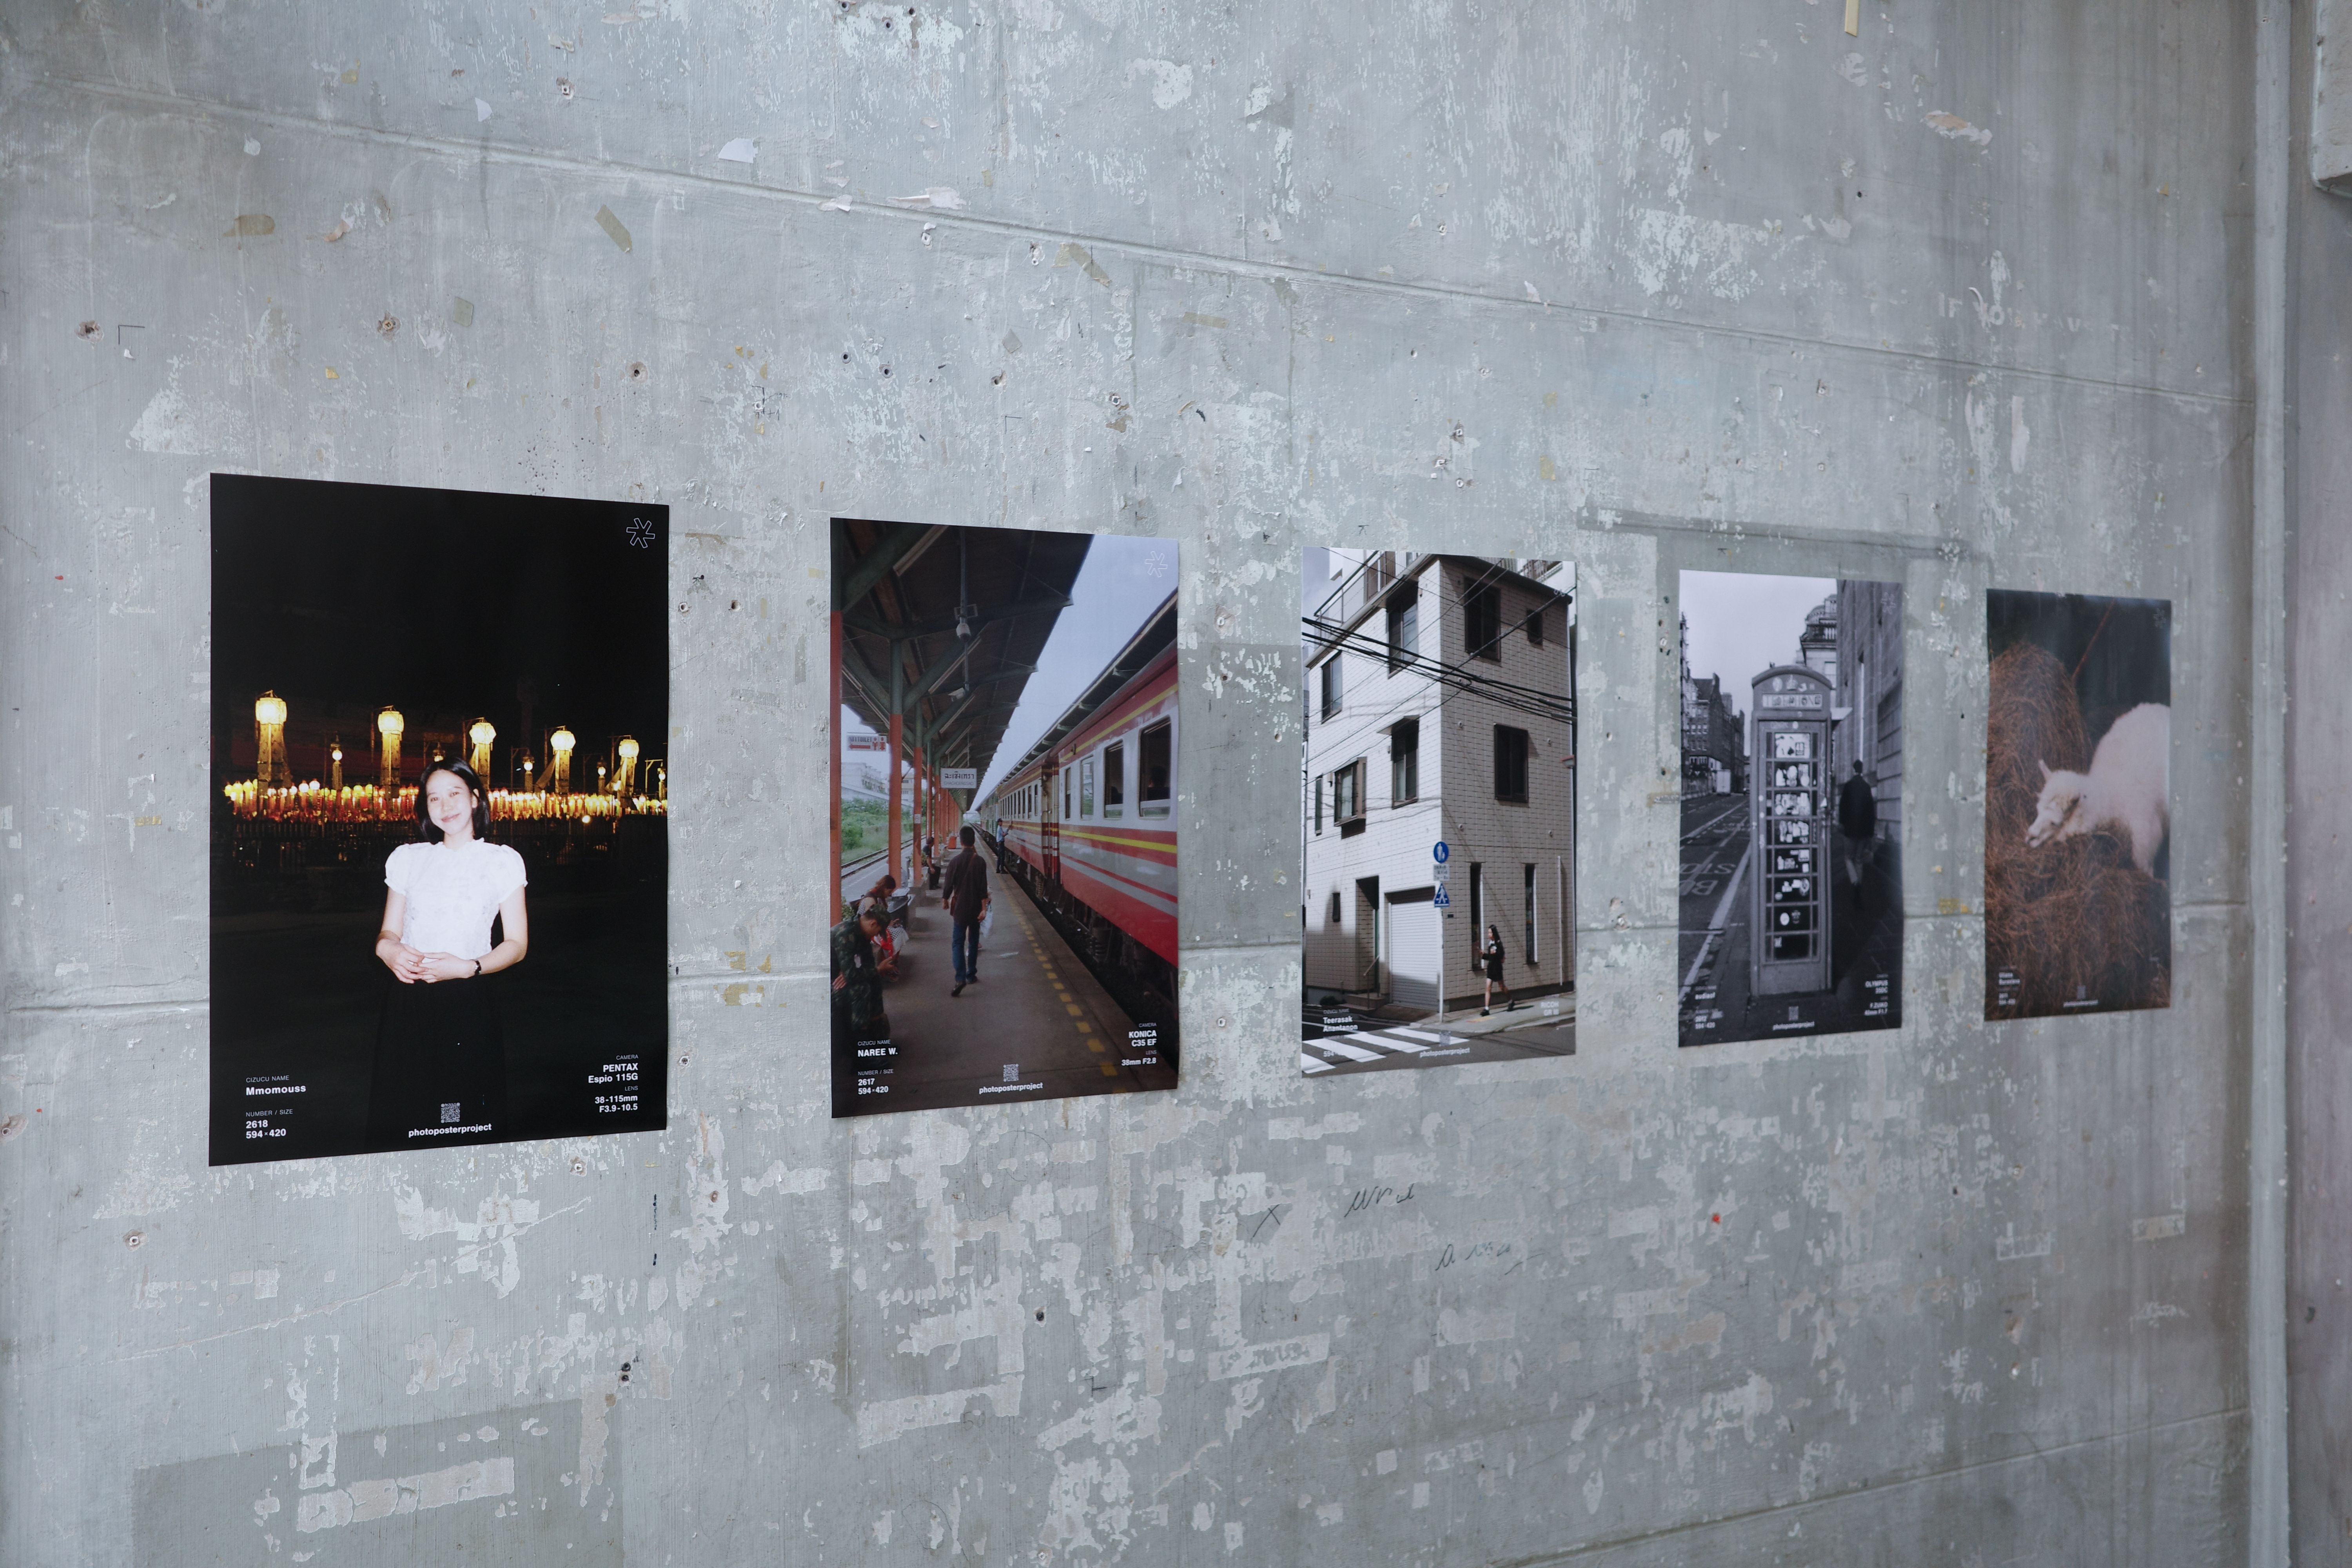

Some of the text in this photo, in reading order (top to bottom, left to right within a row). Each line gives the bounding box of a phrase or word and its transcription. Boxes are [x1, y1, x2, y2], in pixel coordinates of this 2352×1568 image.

[1323, 1015, 1353, 1024] Teerasak
[1129, 1030, 1157, 1038] KONICA
[858, 1048, 886, 1057] NAREE
[1419, 1047, 1470, 1058] photoposterproject
[603, 1063, 638, 1073] PENTAX
[588, 1073, 638, 1084] Espio 115G
[246, 1085, 306, 1096] Mmomouss
[979, 1082, 1043, 1094] photoposterproject
[246, 1120, 268, 1129] 2618
[408, 1123, 492, 1138] photoposterproject
